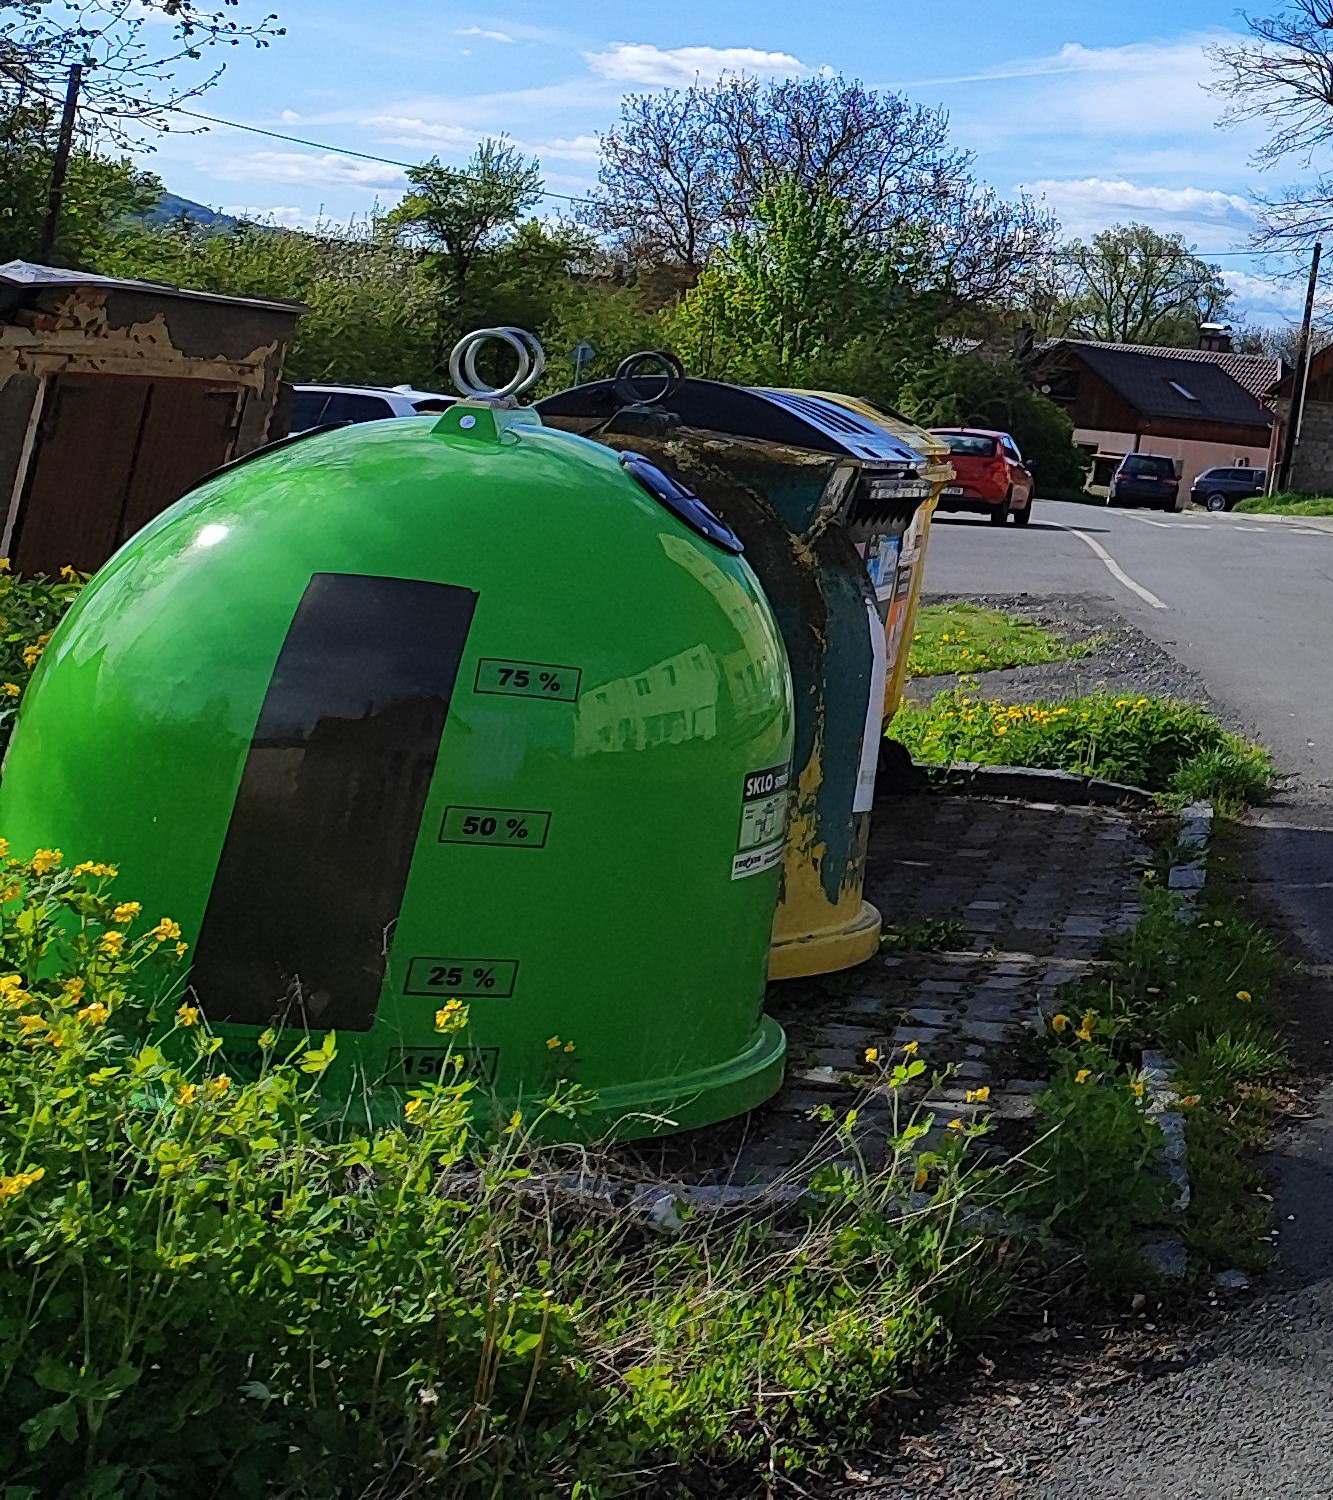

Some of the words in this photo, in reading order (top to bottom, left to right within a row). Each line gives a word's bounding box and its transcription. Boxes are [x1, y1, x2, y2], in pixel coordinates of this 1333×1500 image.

[498, 668, 530, 688] 75
[539, 672, 560, 692] %
[746, 774, 773, 796] SKLO
[462, 816, 497, 836] 50
[506, 818, 528, 838] %
[427, 966, 464, 986] 25
[472, 967, 495, 988] %
